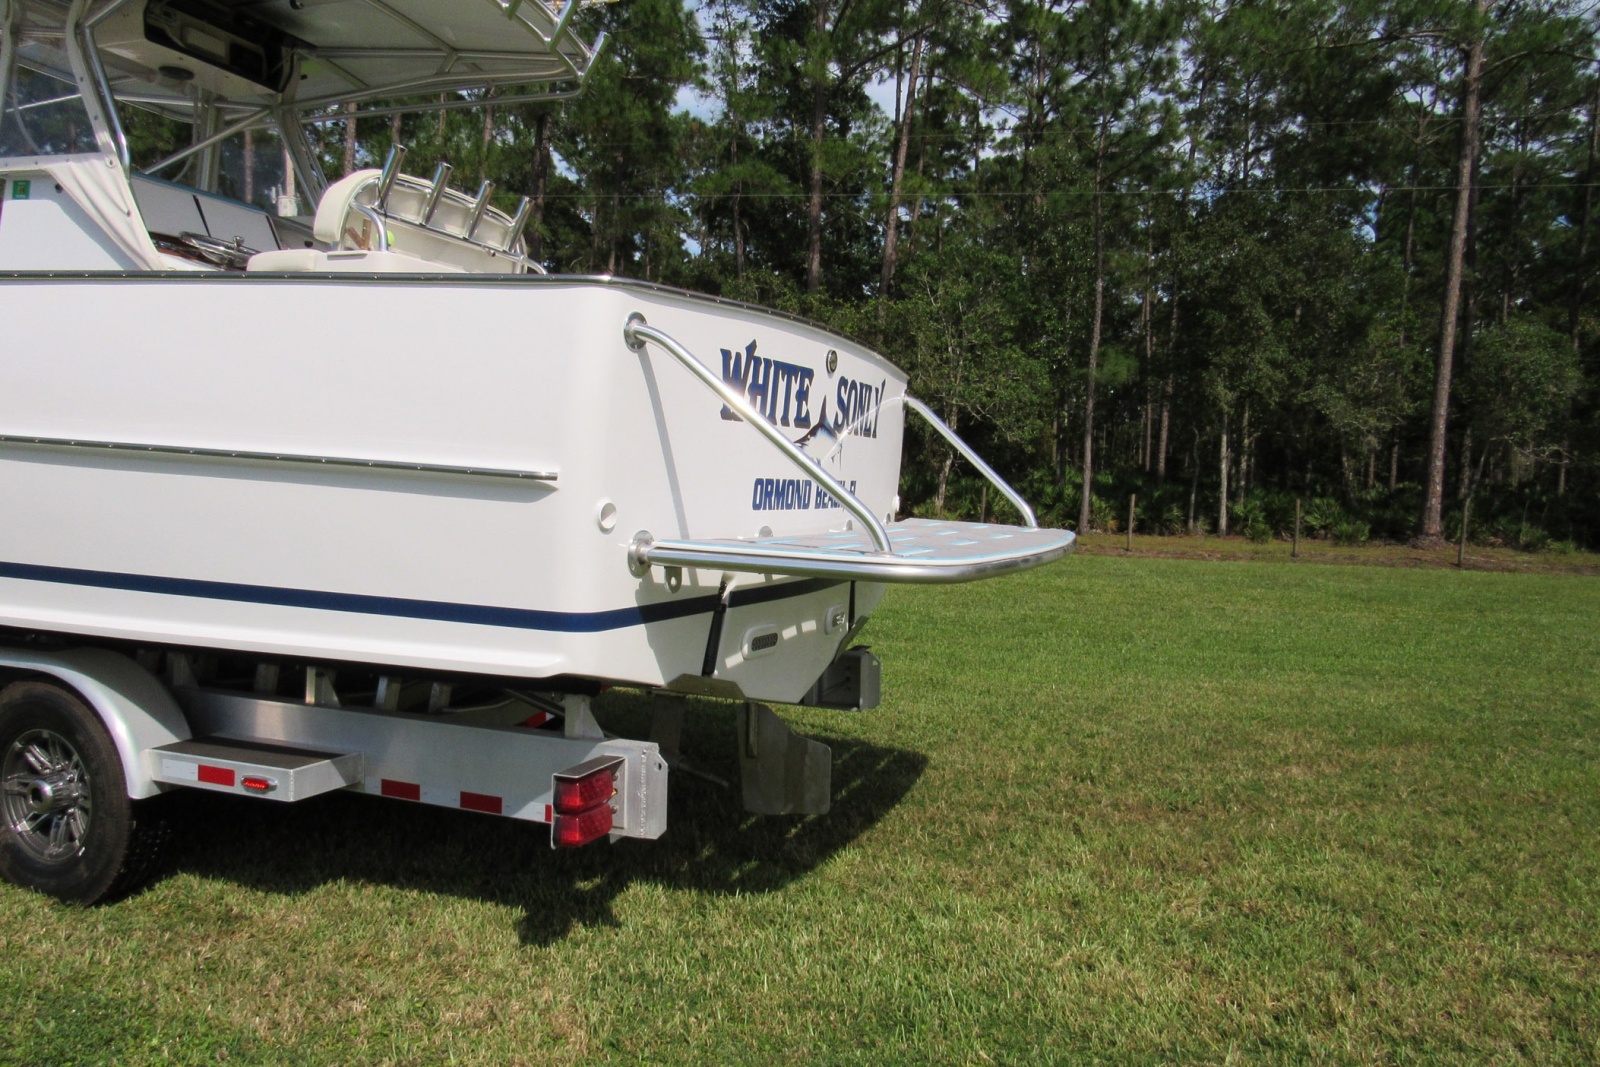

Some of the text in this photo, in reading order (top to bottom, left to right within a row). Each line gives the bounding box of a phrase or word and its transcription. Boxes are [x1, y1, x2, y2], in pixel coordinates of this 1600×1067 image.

[719, 338, 886, 439] WHITE SONLY
[752, 477, 812, 511] ORMOND
[814, 480, 846, 512] BE,
